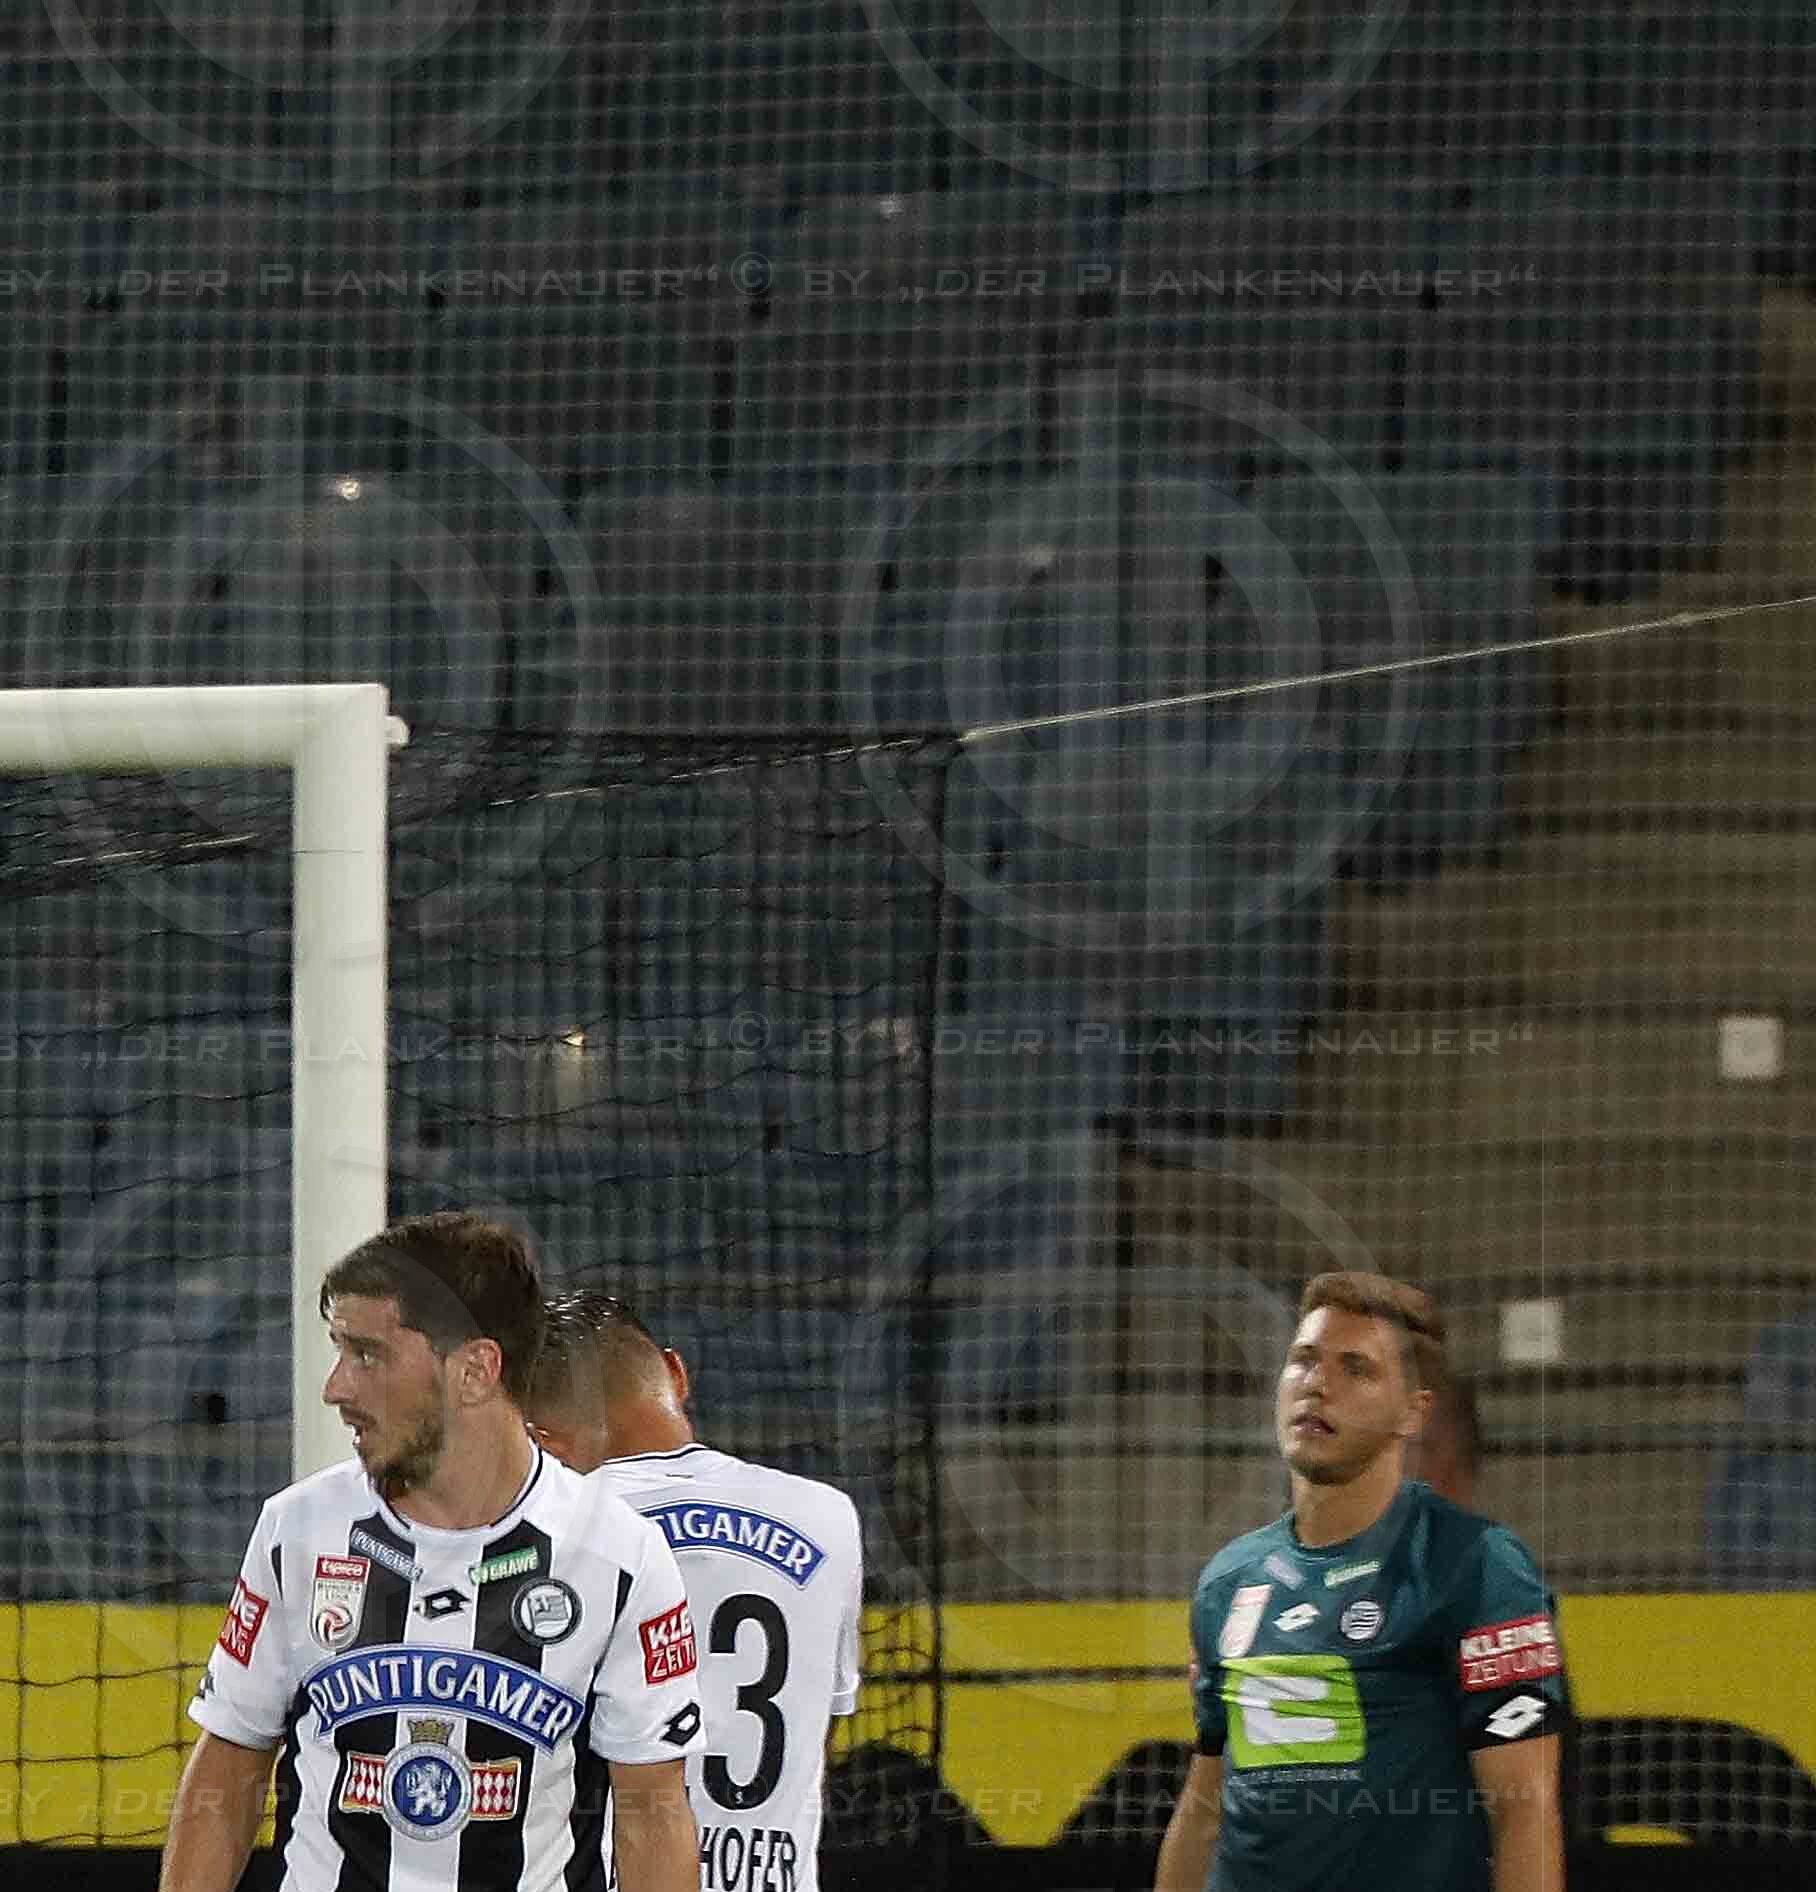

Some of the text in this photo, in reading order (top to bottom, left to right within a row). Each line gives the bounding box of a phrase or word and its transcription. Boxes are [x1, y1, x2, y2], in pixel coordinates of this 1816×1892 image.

[1460, 1621, 1556, 1657] KLEINE
[1465, 1644, 1561, 1685] ZEITUNG
[307, 1656, 574, 1740] PUNTIGAMER
[703, 1593, 790, 1811] 3
